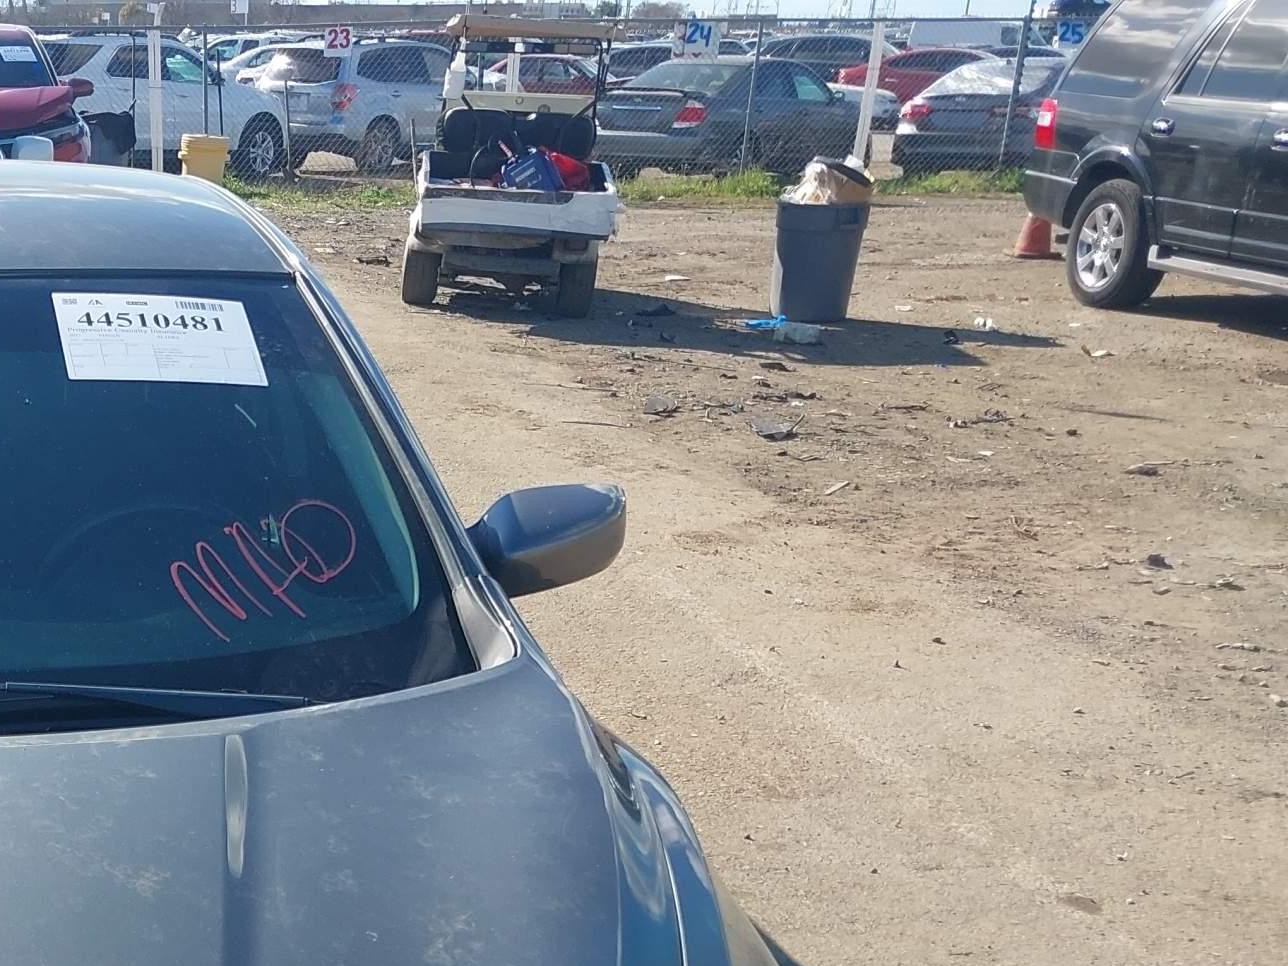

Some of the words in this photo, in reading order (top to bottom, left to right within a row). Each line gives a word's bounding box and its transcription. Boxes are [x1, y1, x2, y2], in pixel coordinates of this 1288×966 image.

[327, 28, 351, 49] 23
[686, 22, 712, 48] 24
[1059, 21, 1084, 44] 25
[77, 311, 225, 332] 44510481
